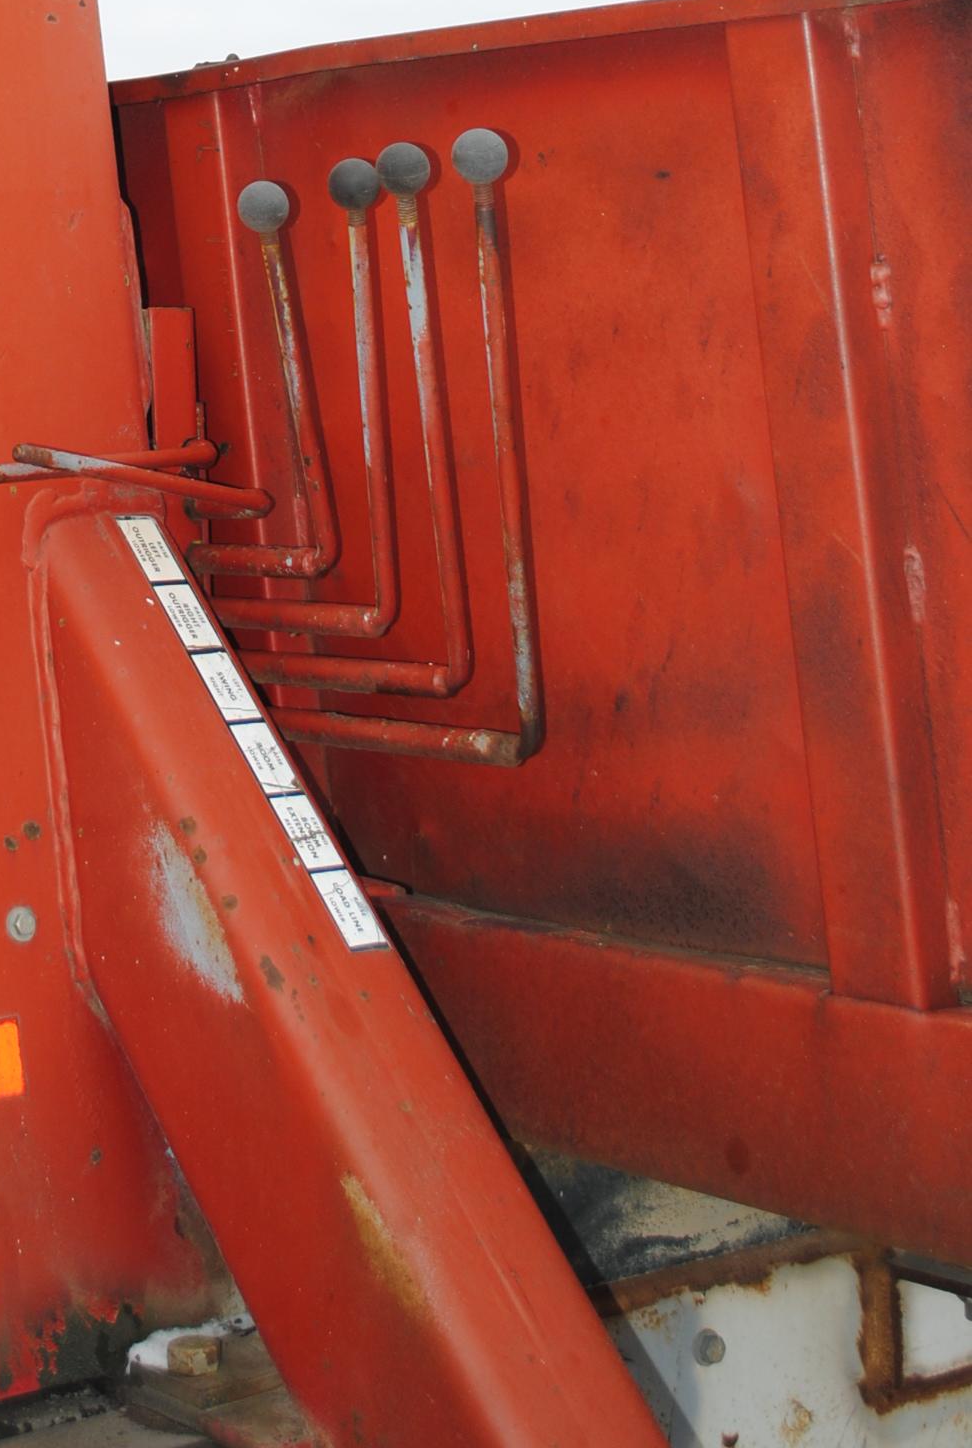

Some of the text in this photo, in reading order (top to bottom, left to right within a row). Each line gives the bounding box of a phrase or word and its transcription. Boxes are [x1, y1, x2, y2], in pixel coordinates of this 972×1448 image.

[131, 525, 161, 573] OUTRIGGER
[131, 540, 147, 563] LOWER
[148, 542, 162, 558] LEFT
[156, 540, 169, 559] RAISE
[167, 605, 183, 629] LOWER
[168, 591, 199, 640] OUTRIGGER
[182, 603, 201, 629] RIGHT
[193, 605, 207, 625] RAISE
[209, 676, 224, 697] RIGHT
[216, 671, 238, 702] SWING
[246, 745, 264, 771] LOWER
[256, 741, 276, 771] BOOM
[329, 896, 346, 924] LOWER
[332, 881, 365, 933] LOAD LINE
